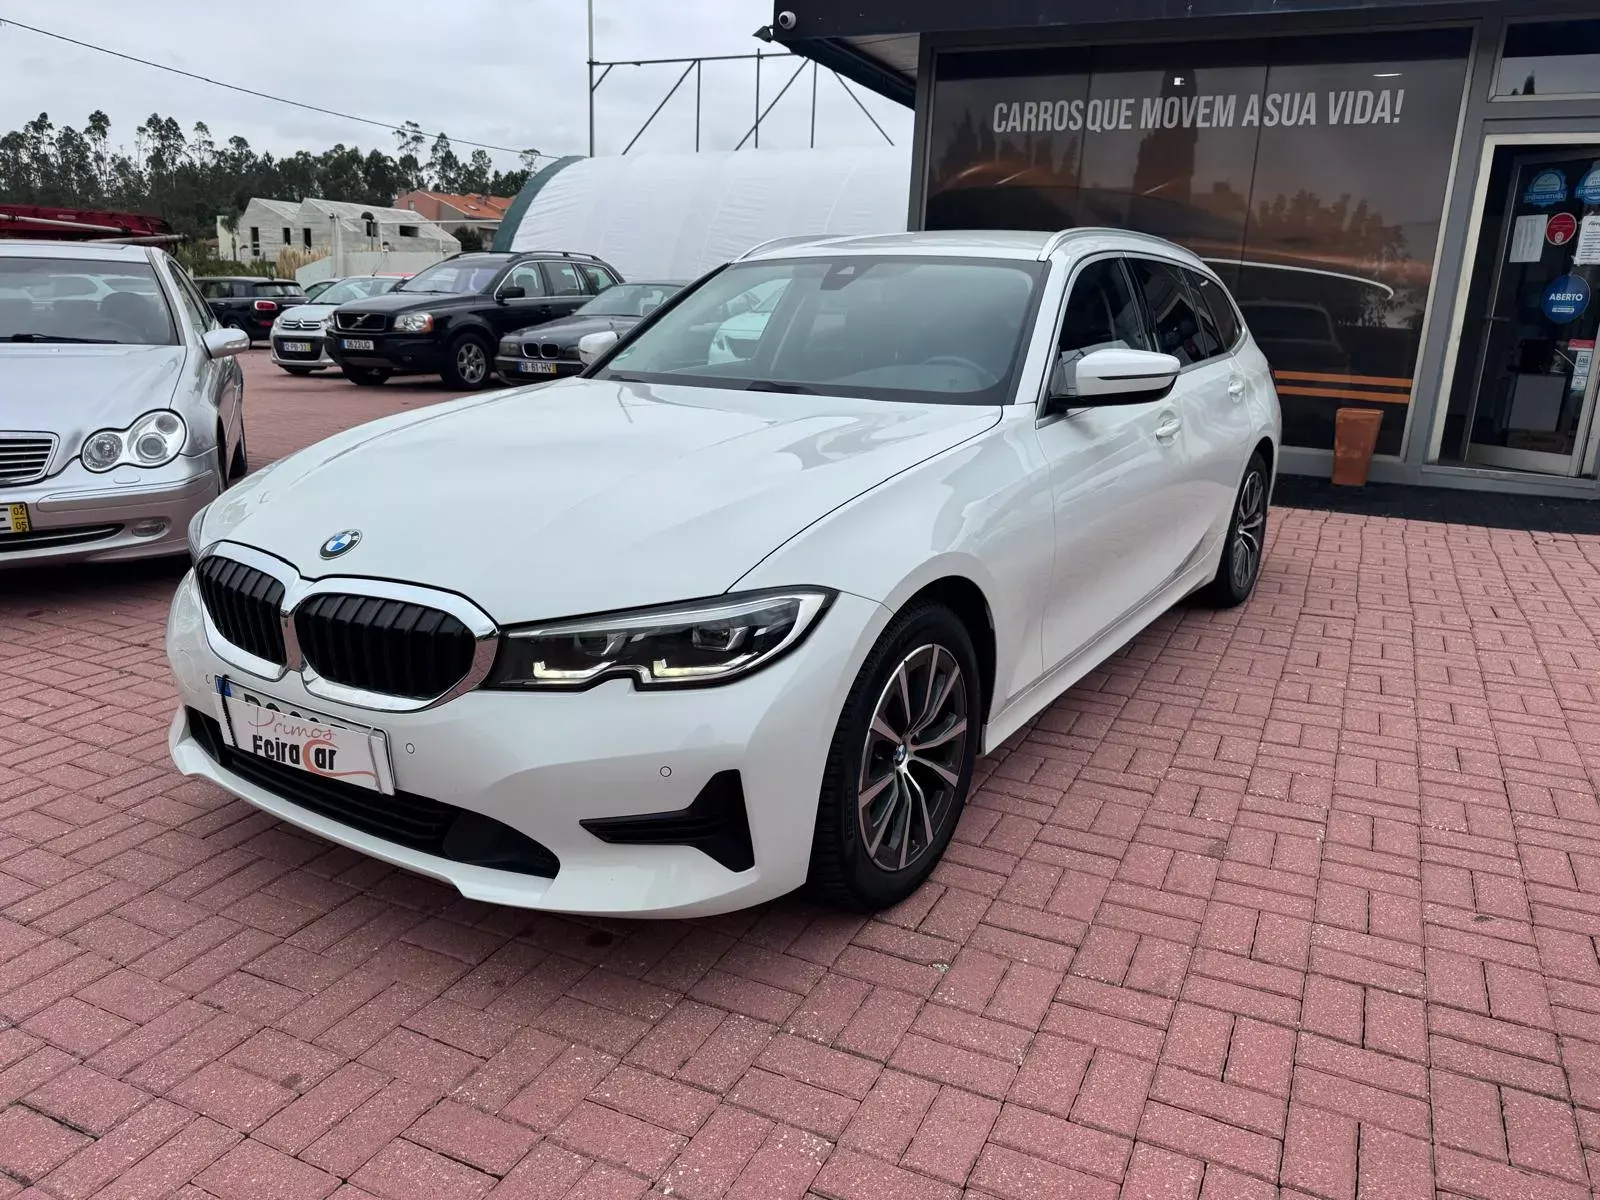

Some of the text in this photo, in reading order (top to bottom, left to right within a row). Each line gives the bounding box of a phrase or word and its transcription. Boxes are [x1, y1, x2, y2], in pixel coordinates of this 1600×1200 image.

[993, 88, 1405, 133] CARROS QUE MOVEM A SUA VIDA!
[1549, 293, 1584, 301] ABERTO
[13, 506, 25, 516] 02
